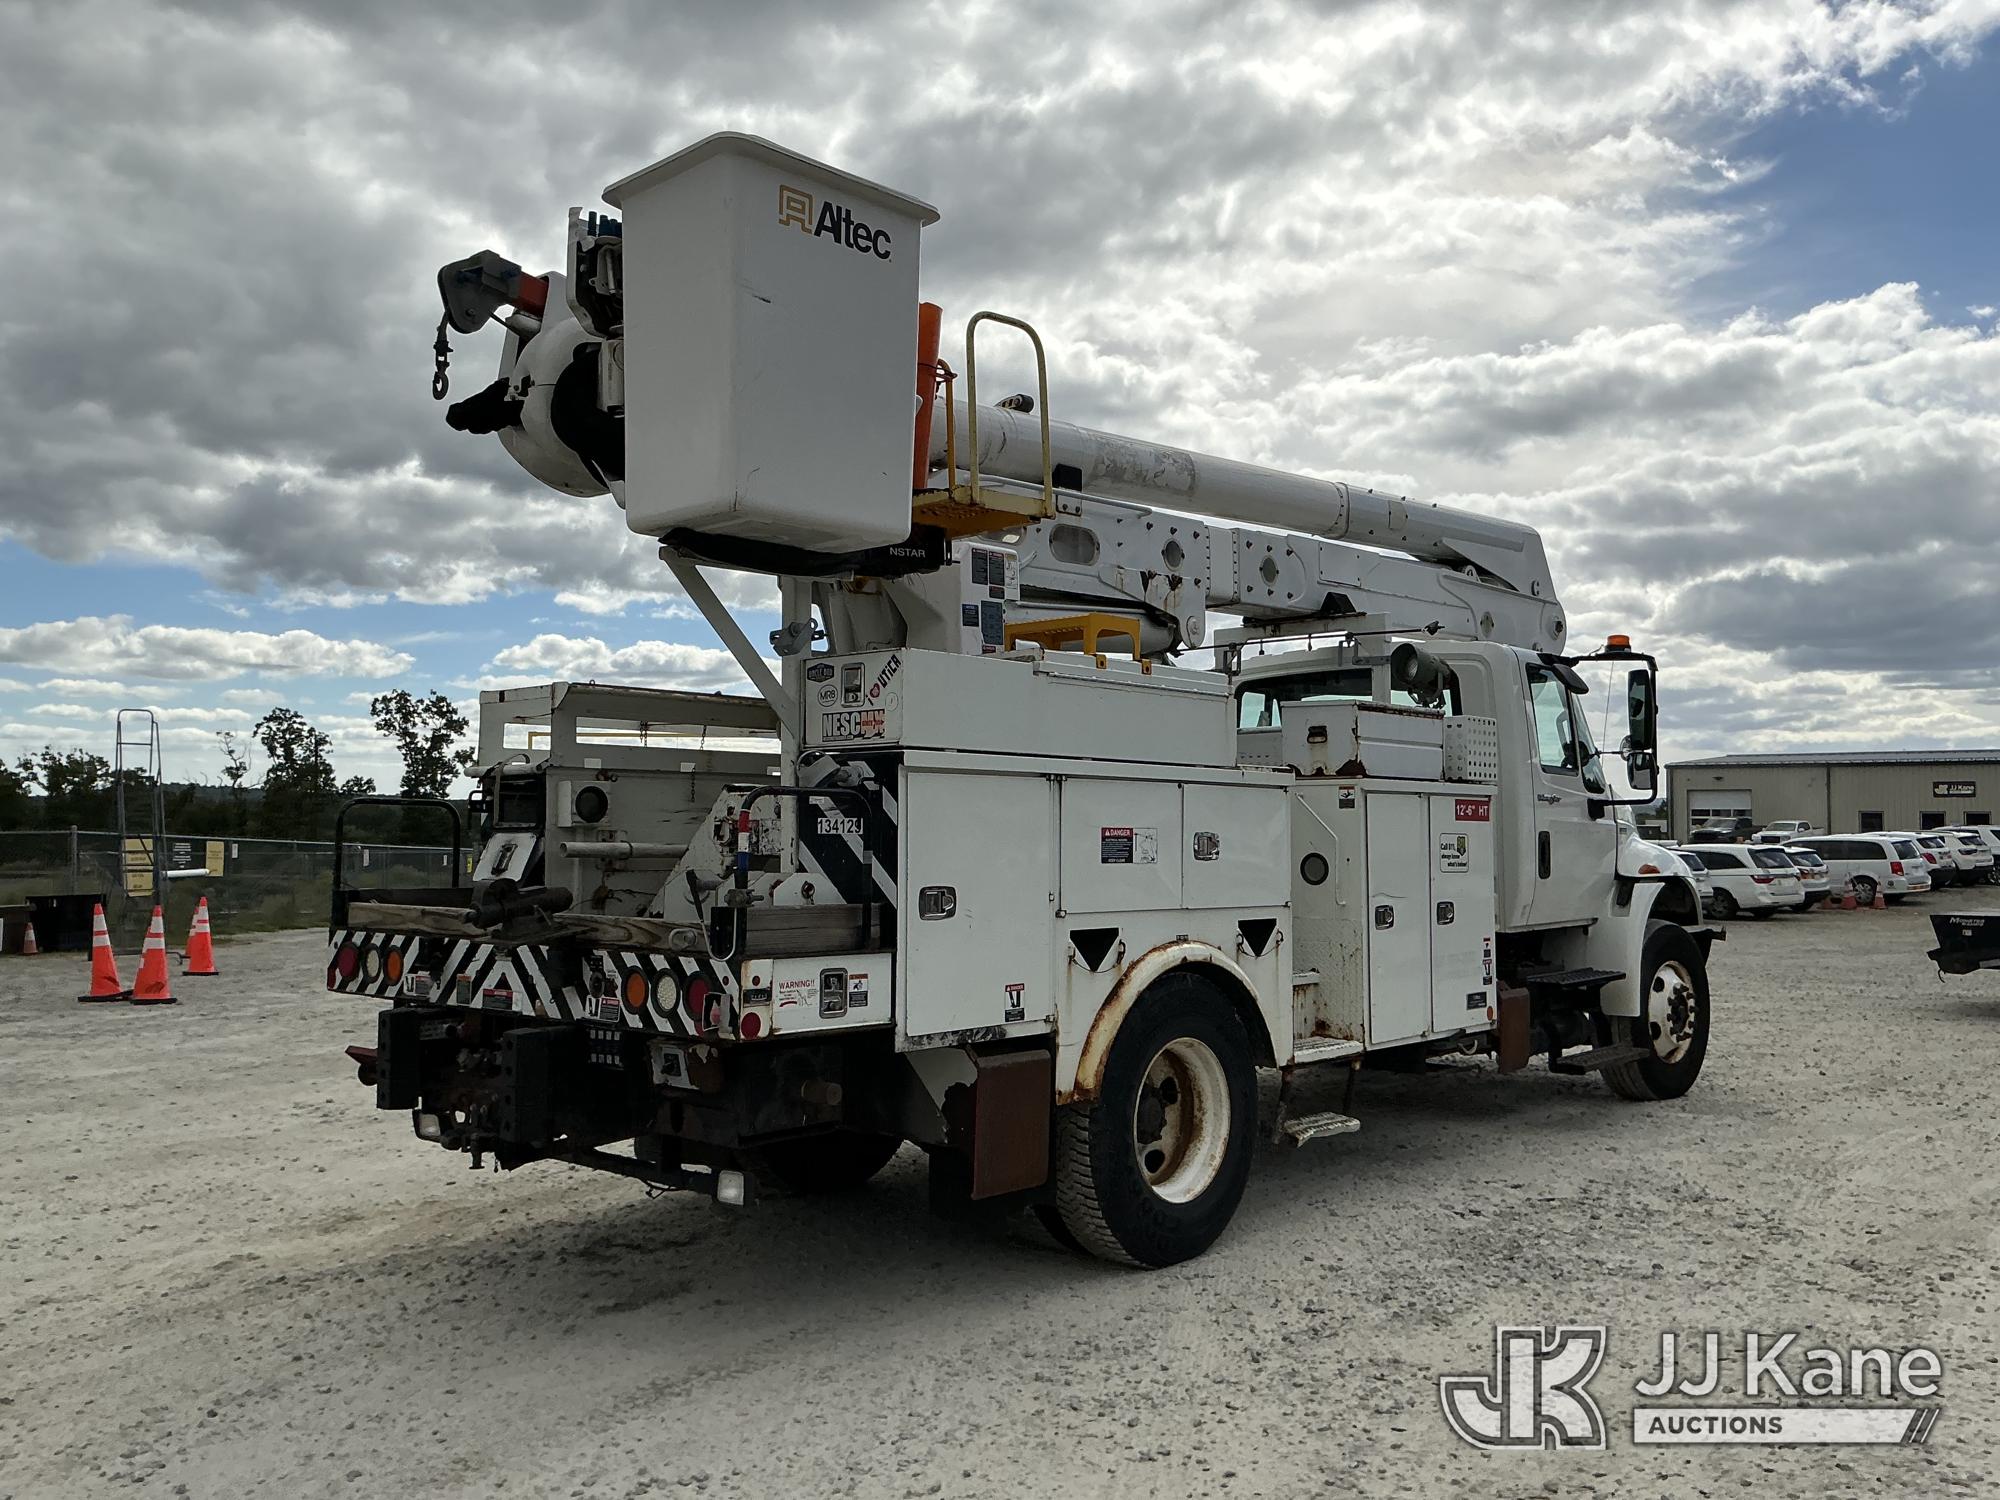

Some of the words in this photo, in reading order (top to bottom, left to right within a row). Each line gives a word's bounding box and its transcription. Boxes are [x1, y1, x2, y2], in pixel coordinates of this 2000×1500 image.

[814, 201, 891, 260] Altec
[889, 547, 926, 558] NSTAR
[1479, 805, 1489, 816] HT
[818, 819, 862, 833] 134129
[779, 979, 815, 990] WARNING!!
